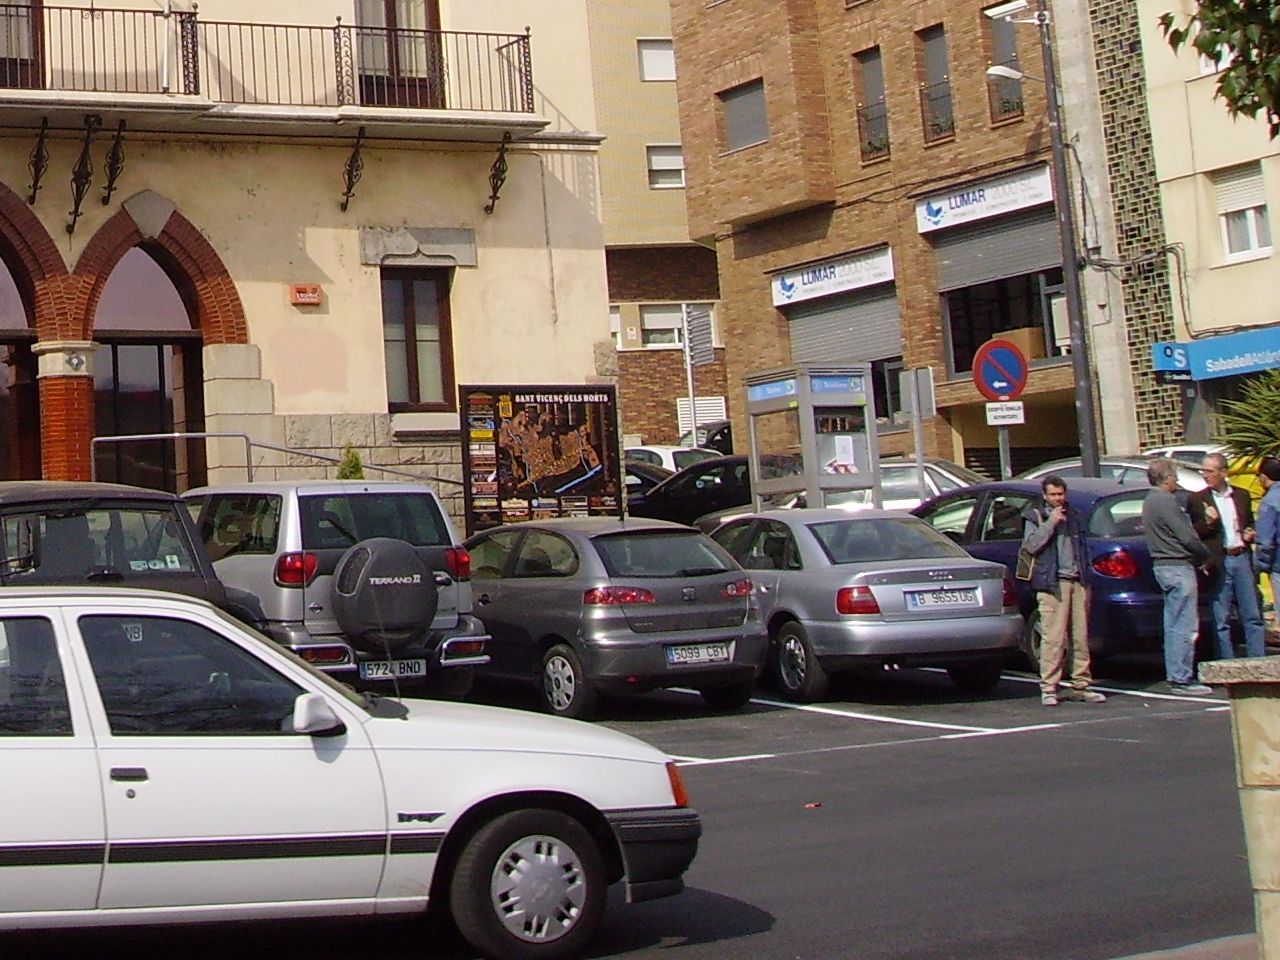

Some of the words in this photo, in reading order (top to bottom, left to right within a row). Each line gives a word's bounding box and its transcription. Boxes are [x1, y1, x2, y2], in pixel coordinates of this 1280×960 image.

[948, 189, 986, 210] LUMAR
[801, 265, 837, 286] LUMAR
[515, 394, 535, 403] SANT
[564, 394, 582, 403] DELS
[583, 394, 609, 403] HORTS
[369, 576, 412, 585] TERRANO
[931, 591, 959, 604] 9655
[673, 646, 701, 660] 5099
[367, 662, 395, 676] 5724
